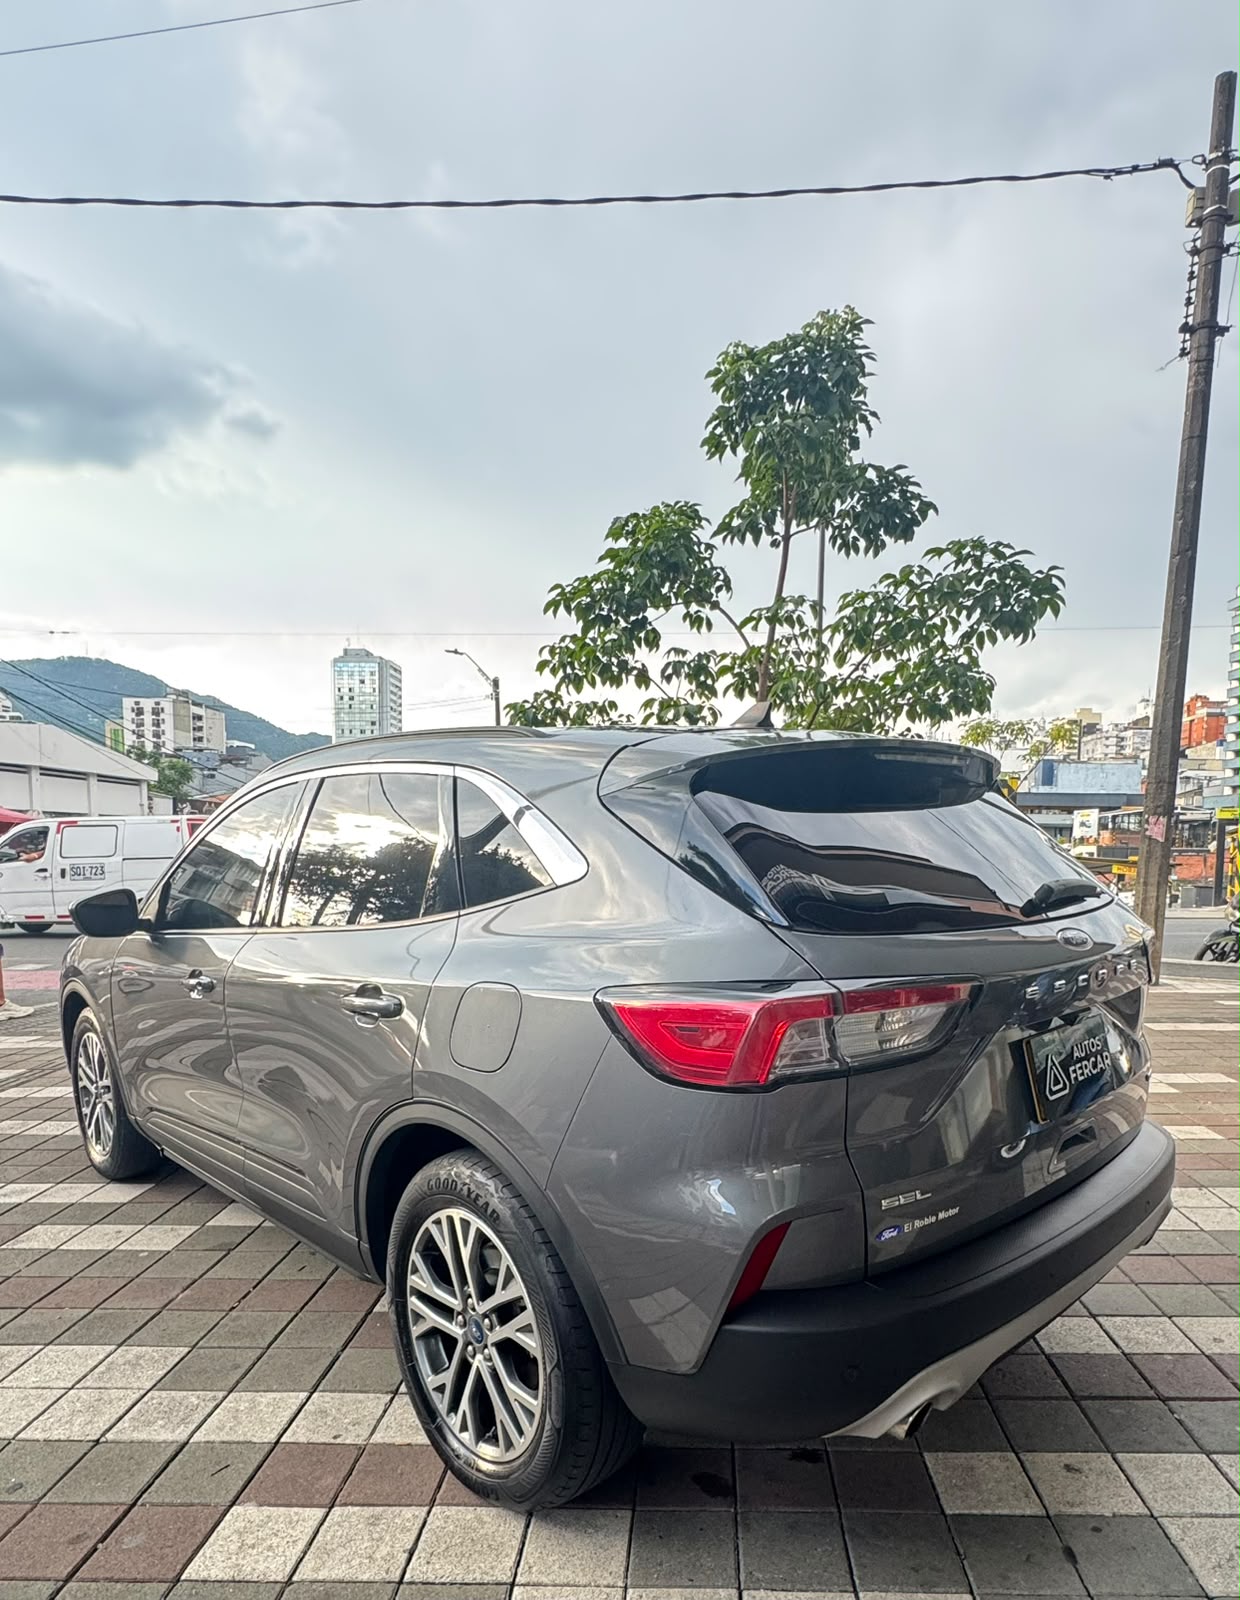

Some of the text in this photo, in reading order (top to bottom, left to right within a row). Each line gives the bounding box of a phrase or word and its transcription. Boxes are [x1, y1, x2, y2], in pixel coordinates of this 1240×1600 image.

[1024, 959, 1138, 999] ESCAPE
[1073, 1036, 1102, 1060] AUTOS
[1069, 1051, 1112, 1085] FERCAR
[881, 1190, 932, 1210] SEL
[880, 1206, 960, 1241] Ford El Roble Motor
